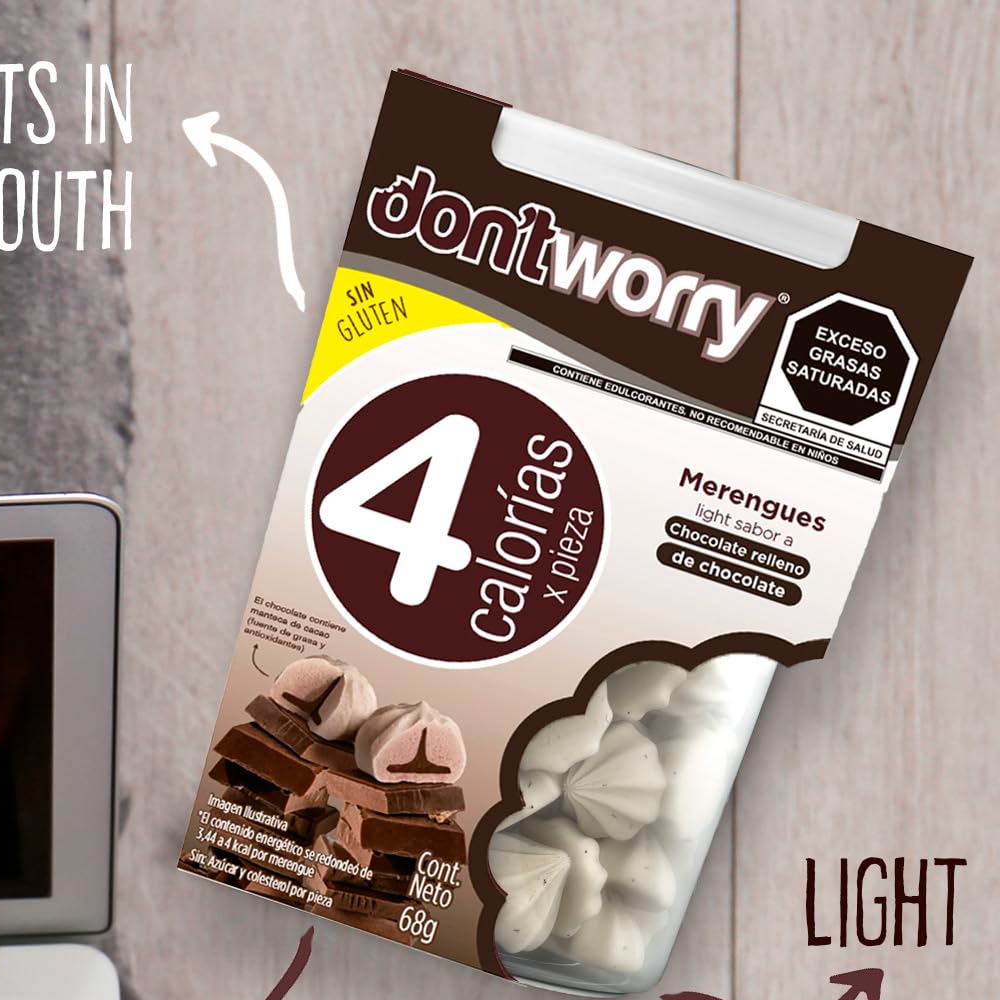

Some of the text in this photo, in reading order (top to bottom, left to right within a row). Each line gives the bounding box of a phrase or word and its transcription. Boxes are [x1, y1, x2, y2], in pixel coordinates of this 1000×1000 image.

[346, 281, 374, 306] SIN
[337, 296, 407, 341] GLUTEN
[809, 346, 882, 380] GRASAS
[815, 326, 887, 359] EXCESO
[786, 360, 892, 405] SATURADAS
[552, 365, 603, 388] CONTIENE
[689, 409, 705, 421] NO
[706, 416, 789, 449] RECOMENDABLE
[791, 442, 806, 454] EN
[807, 446, 839, 465] NIÑOS
[761, 412, 883, 460] SECRETARÍA DE SALUD
[319, 414, 480, 606] 4
[679, 467, 826, 532] Merengues
[470, 434, 573, 643] calorías
[695, 503, 793, 547] light sabor a
[543, 506, 594, 604] x pieza
[669, 522, 804, 576] Chocolate relleno
[671, 551, 786, 598] de chocolate
[250, 608, 330, 639] manteca de cacao
[254, 596, 347, 633] El chocolate contiene
[280, 628, 291, 637] de
[320, 642, 326, 650] y
[207, 794, 244, 817] Imagen
[195, 827, 216, 844] 3,44
[224, 836, 231, 849] 4
[231, 838, 250, 855] kcal
[250, 847, 266, 861] por
[268, 853, 316, 879] merengue
[210, 815, 255, 840] contenido
[255, 831, 304, 856] energético
[304, 848, 315, 859] se
[315, 853, 359, 876] redondeó
[360, 867, 373, 881] de
[418, 851, 460, 886] Cont.
[208, 854, 240, 876] Azúcar
[247, 870, 290, 892] colesterol
[291, 884, 307, 899] por
[307, 890, 333, 908] pieza
[408, 873, 452, 908] Neto
[399, 906, 438, 944] 68g
